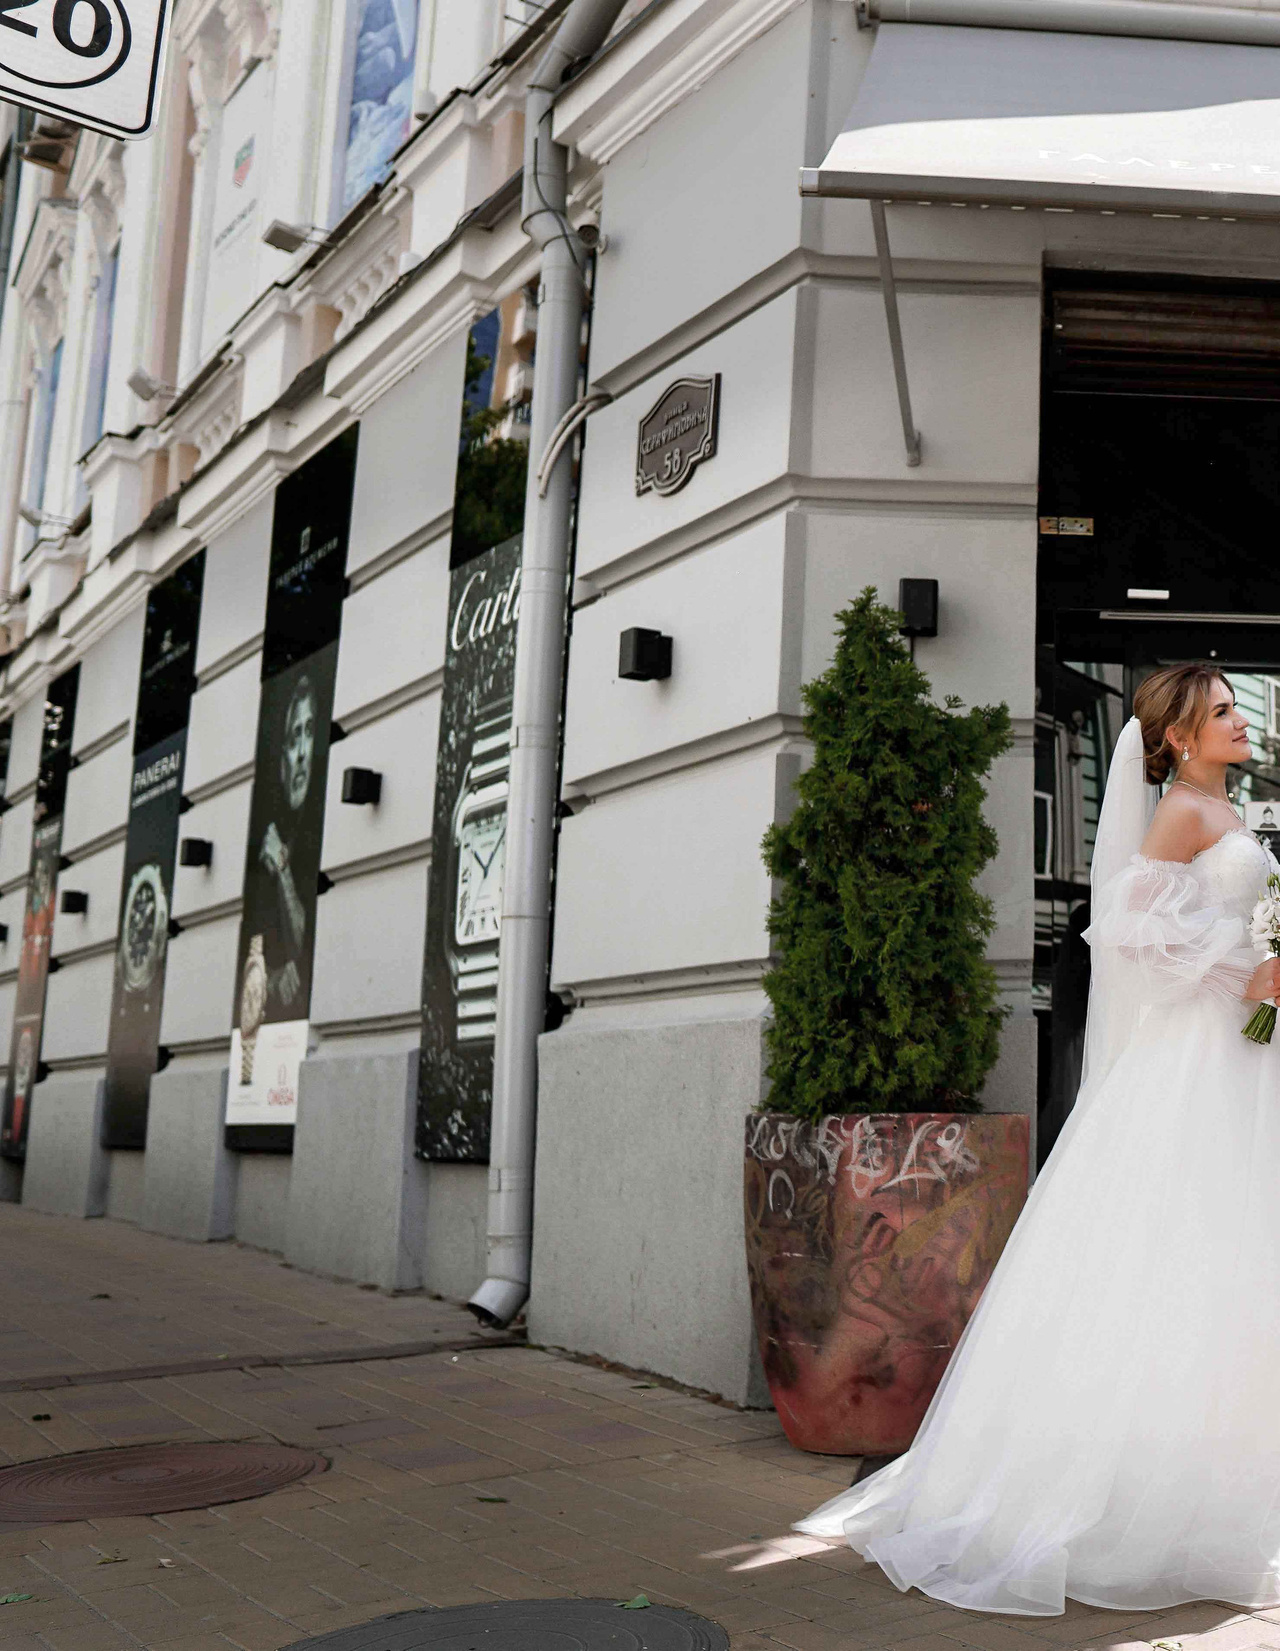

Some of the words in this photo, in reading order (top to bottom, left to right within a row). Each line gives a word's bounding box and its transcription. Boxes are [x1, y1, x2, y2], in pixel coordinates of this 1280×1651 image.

[663, 448, 681, 479] 58
[451, 566, 522, 651] Cart
[134, 750, 182, 792] PANERAI
